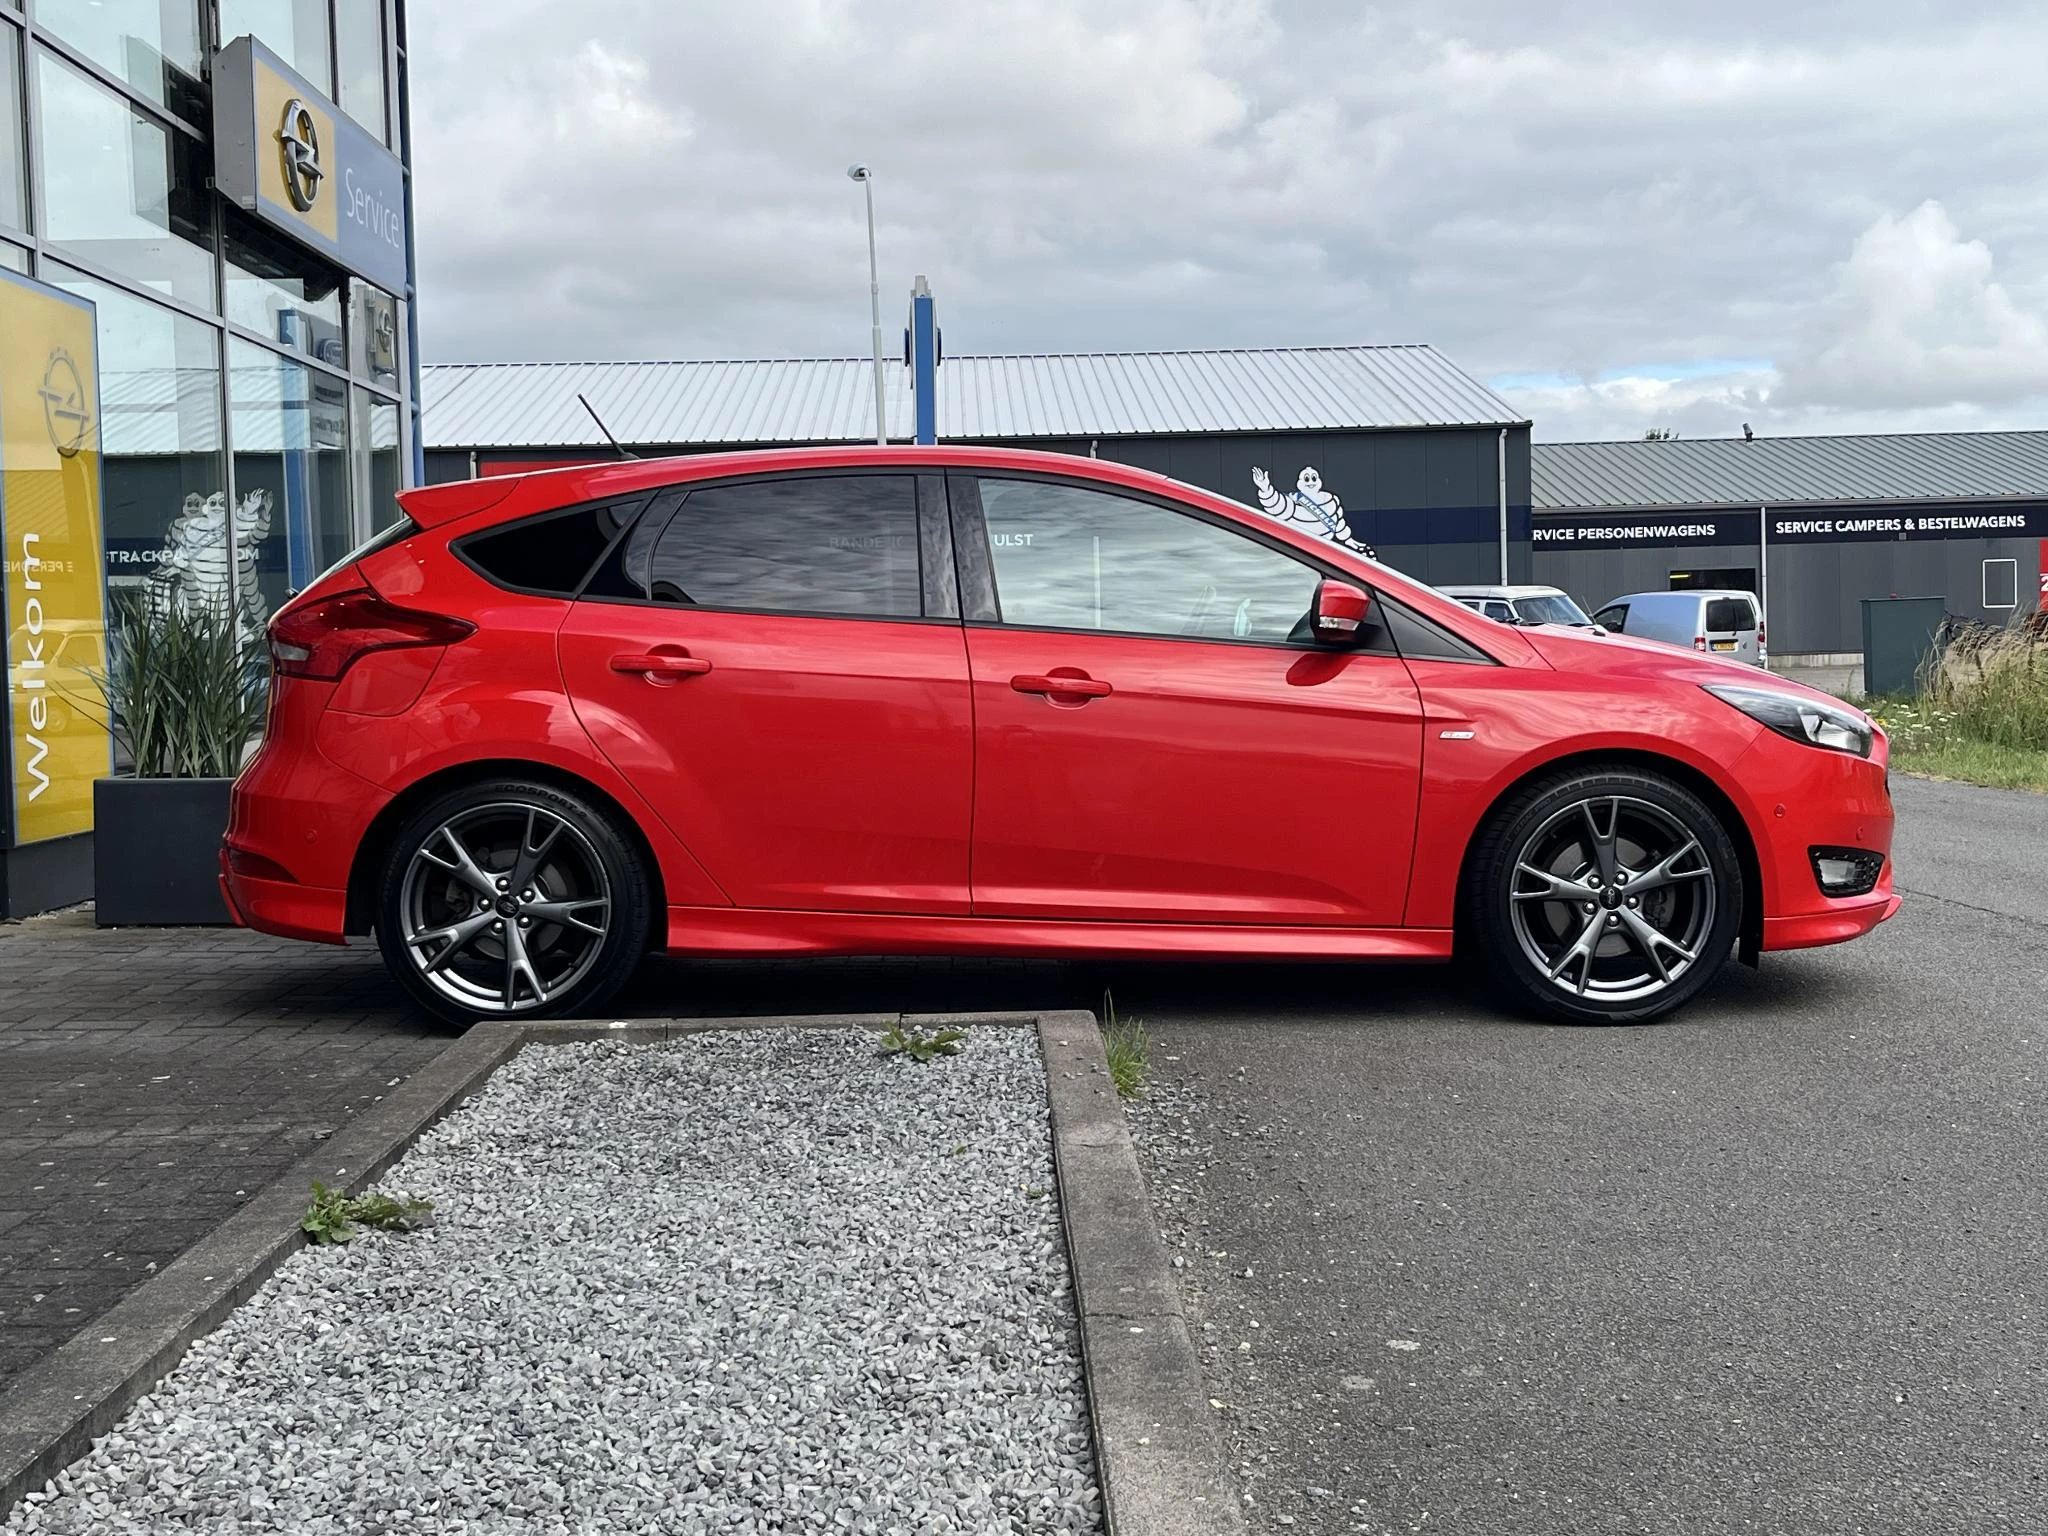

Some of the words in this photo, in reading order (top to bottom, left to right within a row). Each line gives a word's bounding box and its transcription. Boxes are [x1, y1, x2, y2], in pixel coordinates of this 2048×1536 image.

[345, 168, 399, 248] Service
[1532, 528, 1575, 541] RVICE
[1578, 524, 1716, 540] PERSONENWAGENS
[1775, 520, 1832, 534] SERVICE
[1835, 518, 1901, 532] CAMPERS
[1904, 518, 1915, 530] &
[1918, 515, 2025, 530] BESTELWAGENS
[22, 533, 50, 802] Welkom
